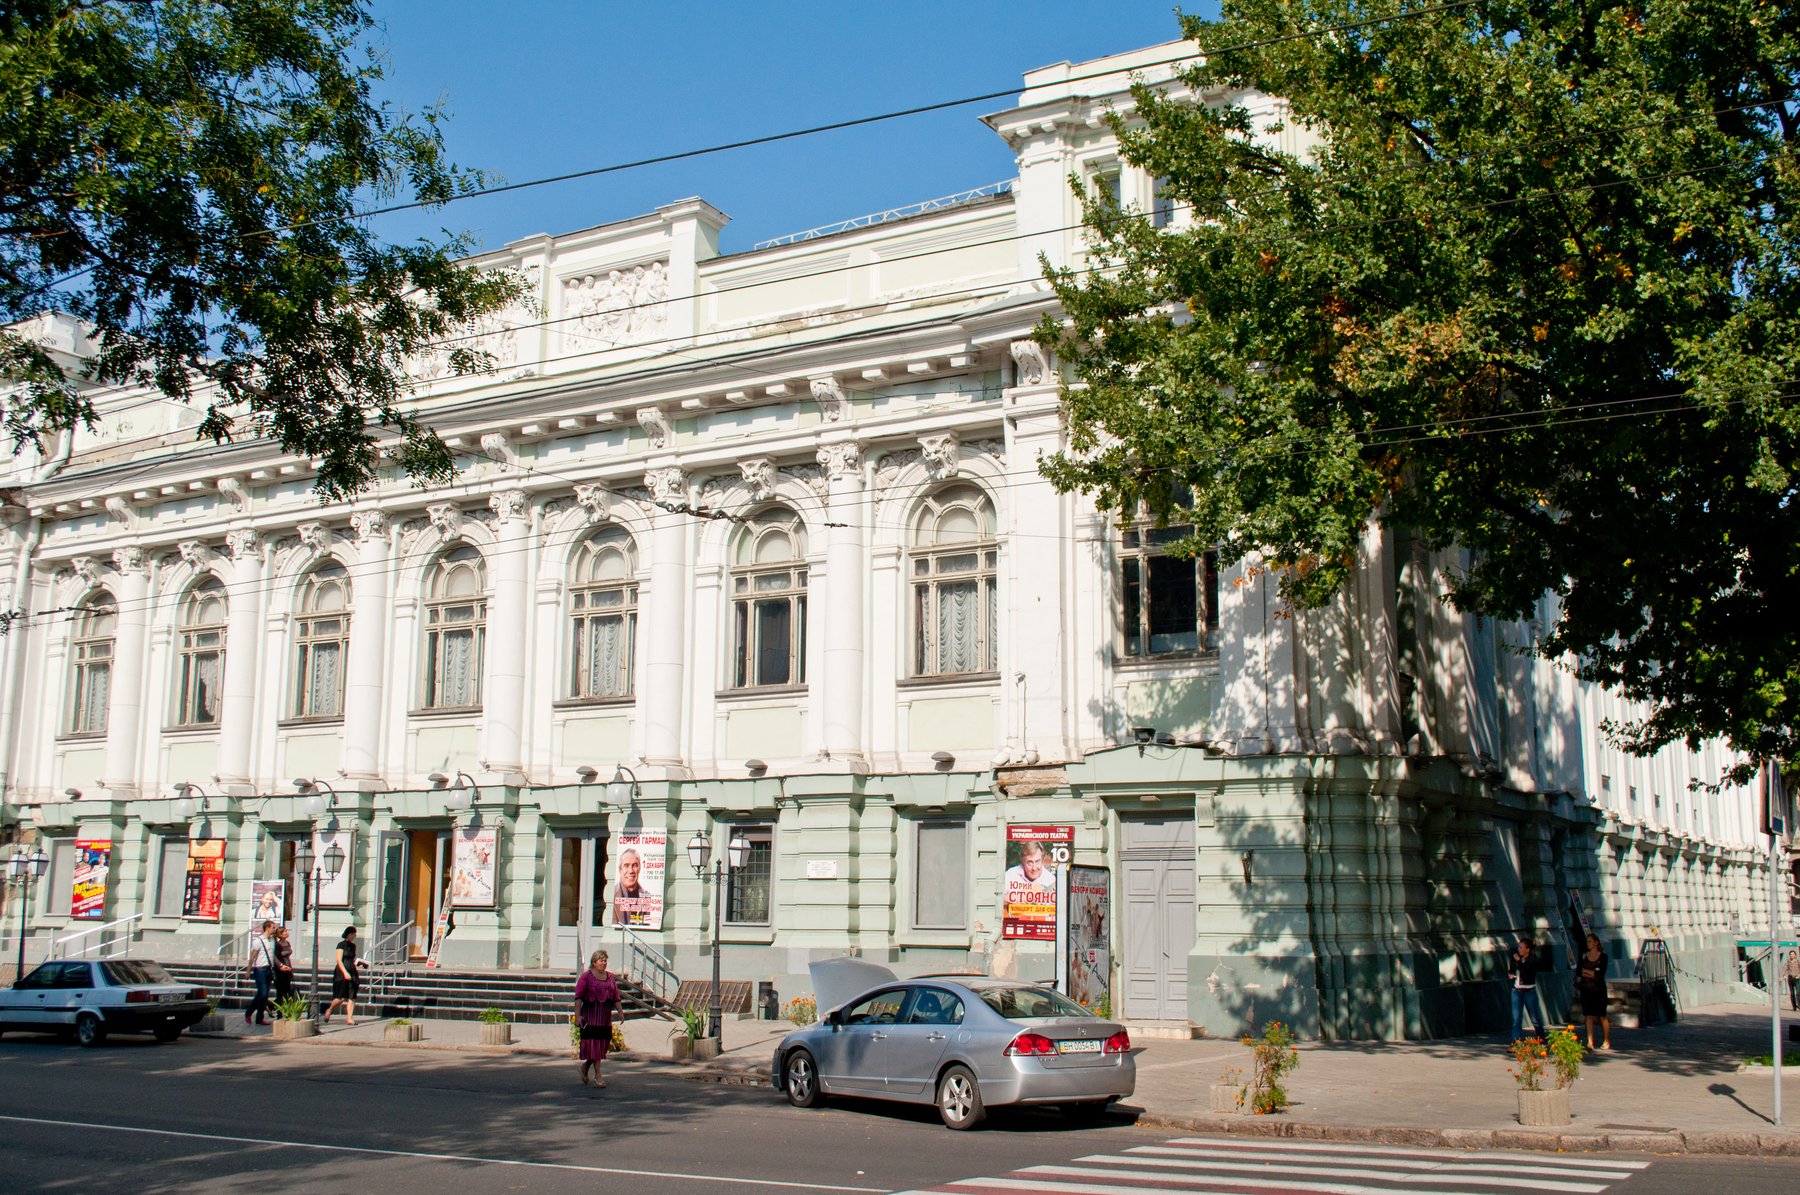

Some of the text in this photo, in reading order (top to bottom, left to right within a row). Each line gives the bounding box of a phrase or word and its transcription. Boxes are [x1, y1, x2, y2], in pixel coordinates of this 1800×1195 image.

[618, 835, 665, 844] СЕРГЕЙ ГАРМАШ
[1051, 847, 1070, 862] 10
[1009, 891, 1056, 903] СТОЯНО
